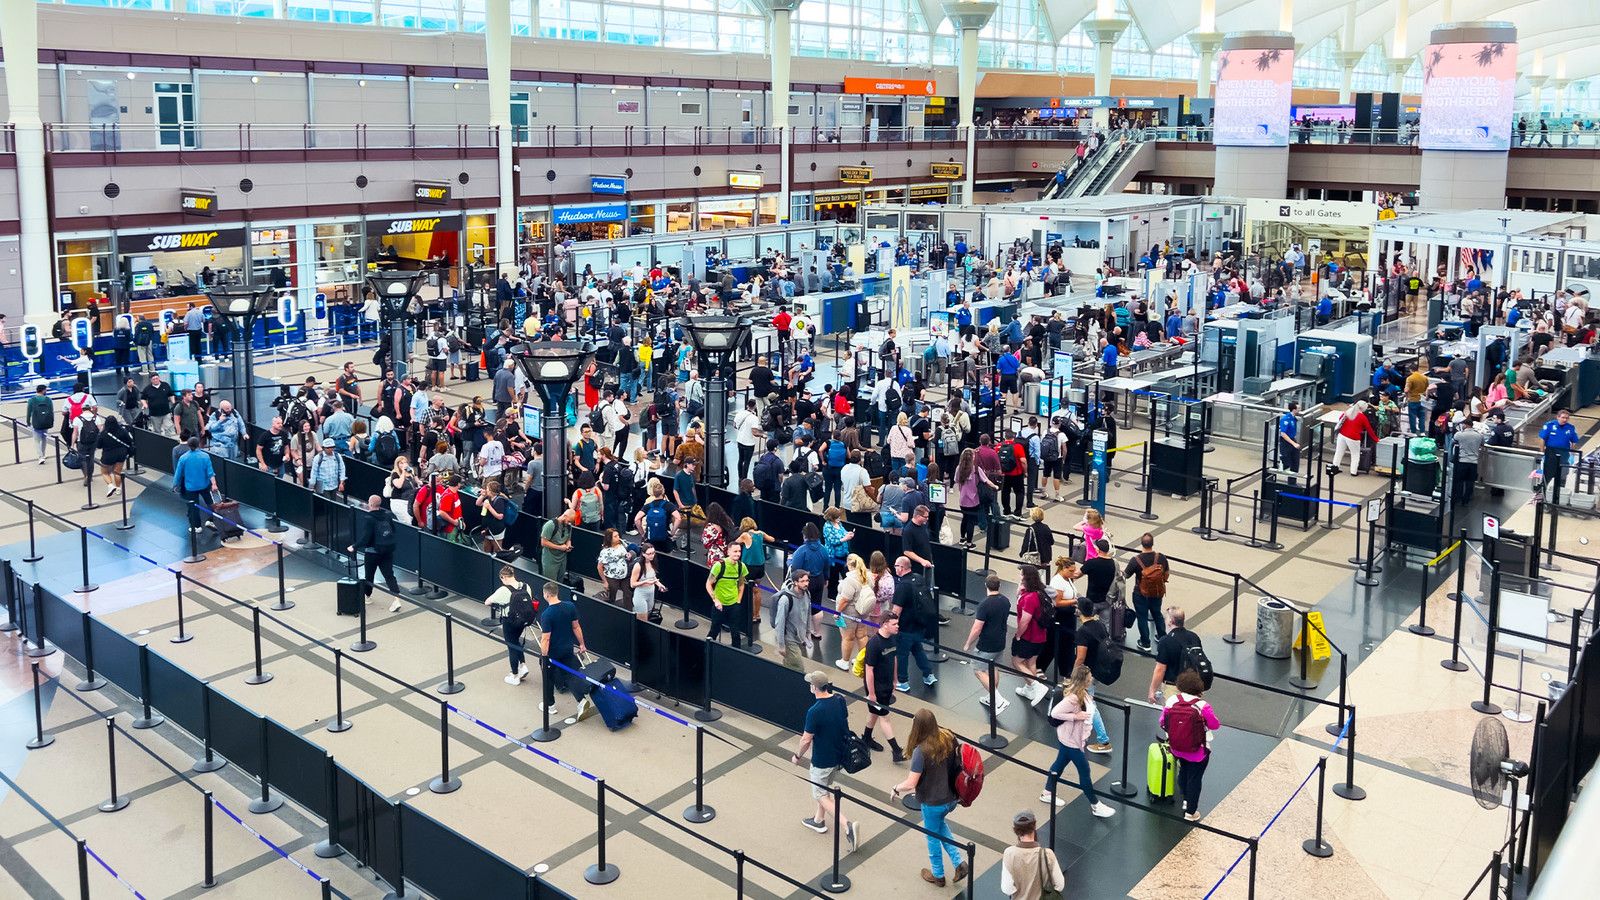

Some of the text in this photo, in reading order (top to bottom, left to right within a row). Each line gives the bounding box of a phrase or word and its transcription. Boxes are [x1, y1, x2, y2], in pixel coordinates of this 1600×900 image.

[416, 187, 446, 199] SUBWAY
[183, 197, 211, 209] SUBWAY
[558, 210, 621, 221] Hudson News
[1294, 208, 1342, 218] to all Gates
[386, 218, 441, 233] SUBWAY
[147, 231, 219, 250] SUBWAY
